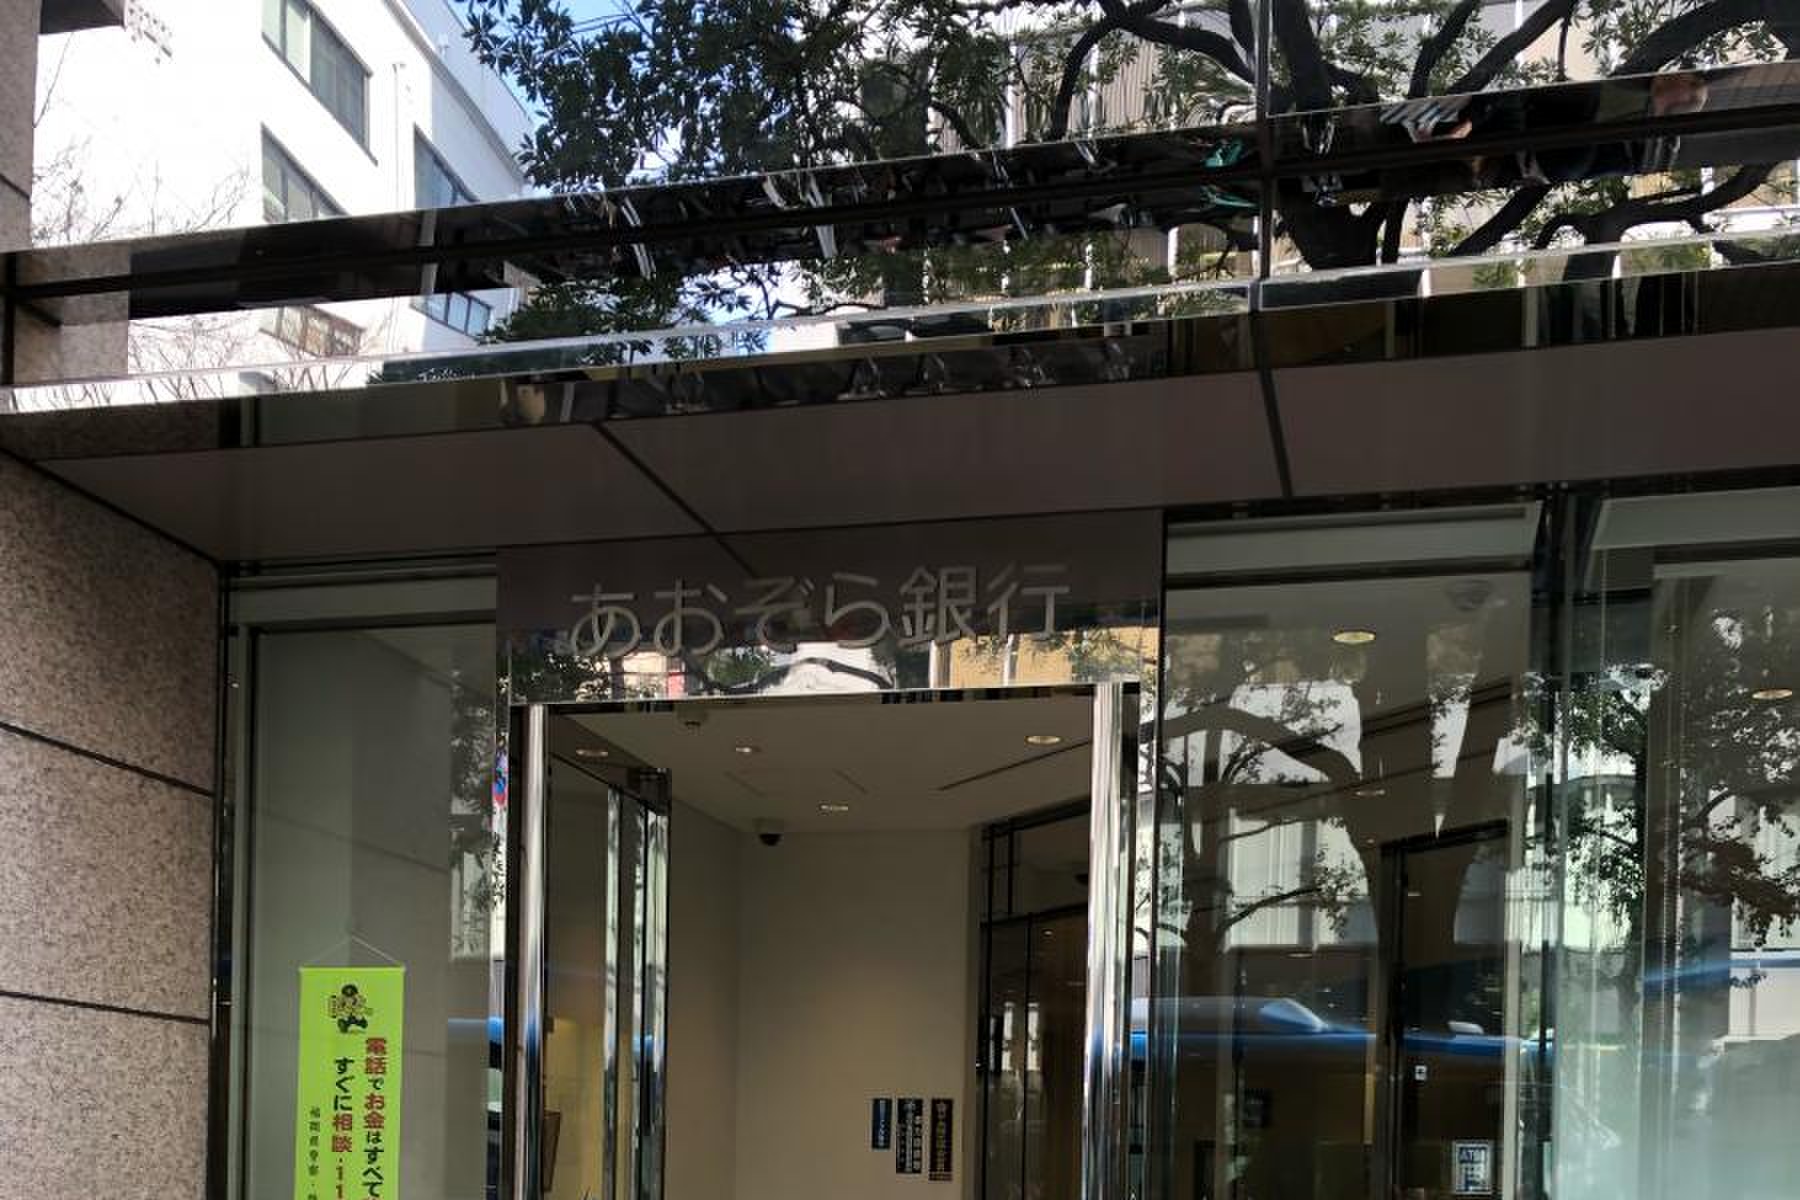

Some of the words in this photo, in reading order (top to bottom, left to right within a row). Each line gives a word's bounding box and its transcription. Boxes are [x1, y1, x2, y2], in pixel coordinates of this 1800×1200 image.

[571, 563, 1071, 658] あおぞら銀行
